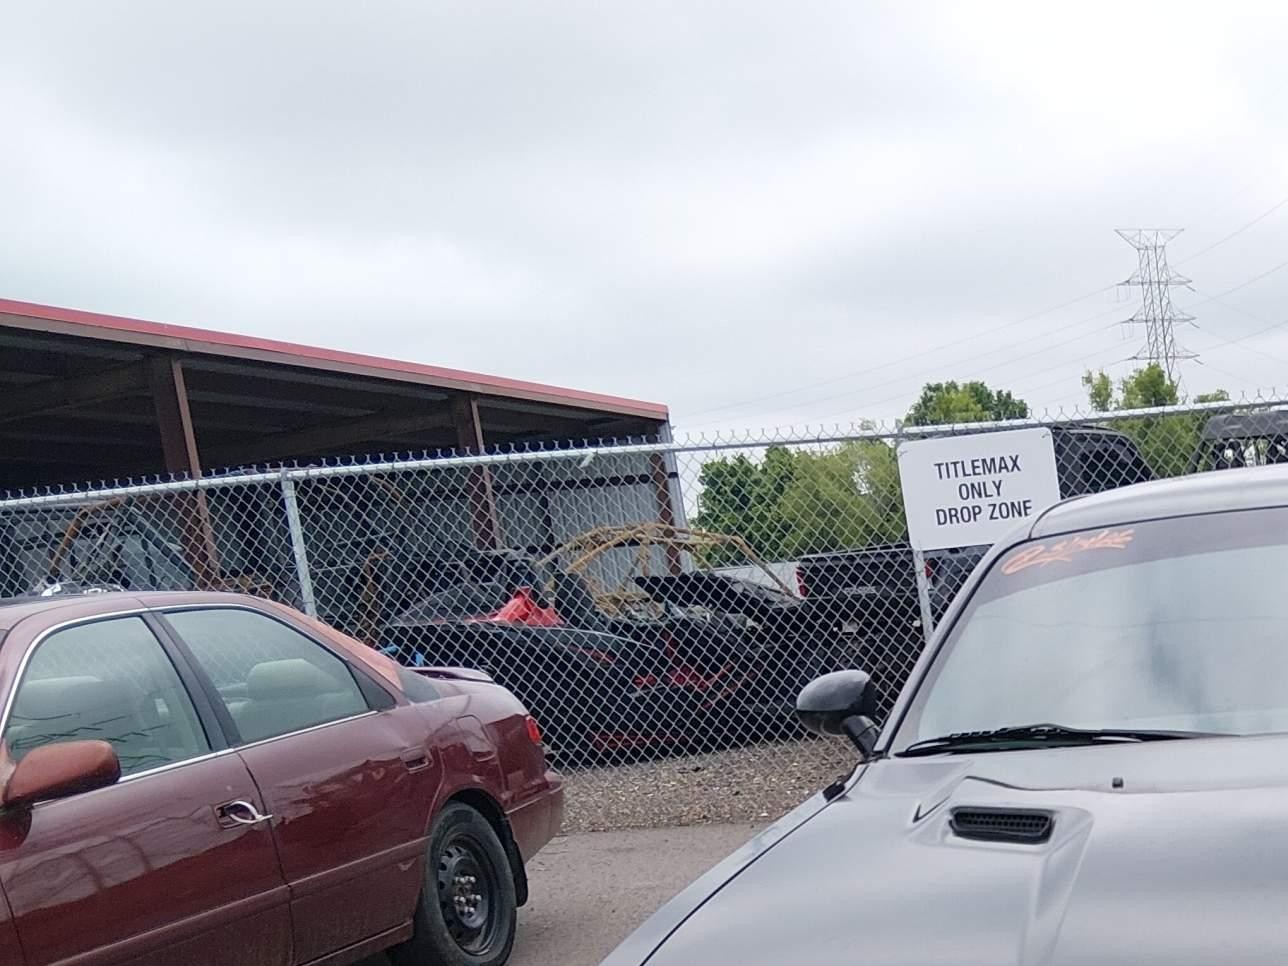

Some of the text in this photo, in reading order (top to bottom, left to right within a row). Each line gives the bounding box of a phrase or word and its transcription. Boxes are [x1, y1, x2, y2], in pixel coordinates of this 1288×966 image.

[934, 455, 1021, 480] TITLEMAX
[958, 480, 1002, 501] ONLY
[936, 500, 1032, 526] DROP ZONE
